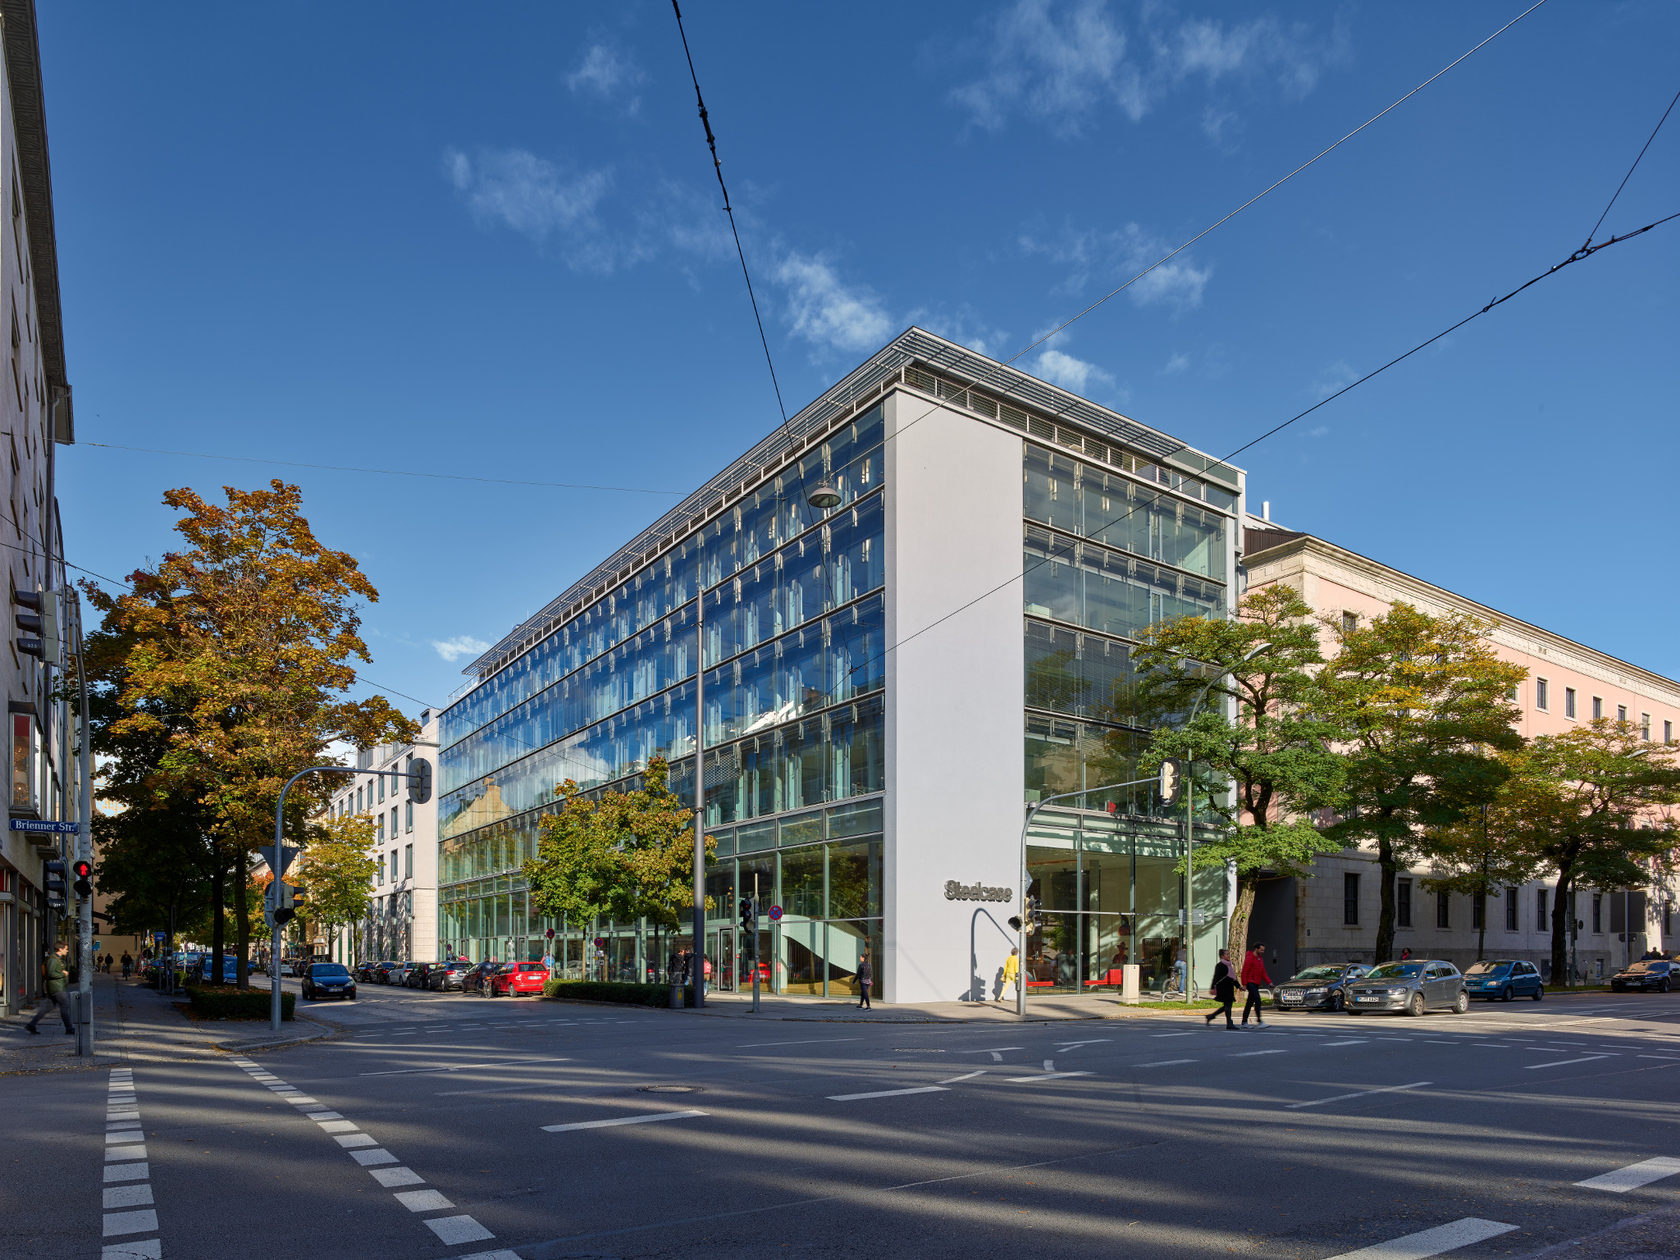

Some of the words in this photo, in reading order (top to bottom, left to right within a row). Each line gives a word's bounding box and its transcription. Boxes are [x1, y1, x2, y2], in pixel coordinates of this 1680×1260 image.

[15, 820, 57, 831] Brienner
[58, 822, 75, 832] Str.
[944, 879, 1013, 902] Steelcase
